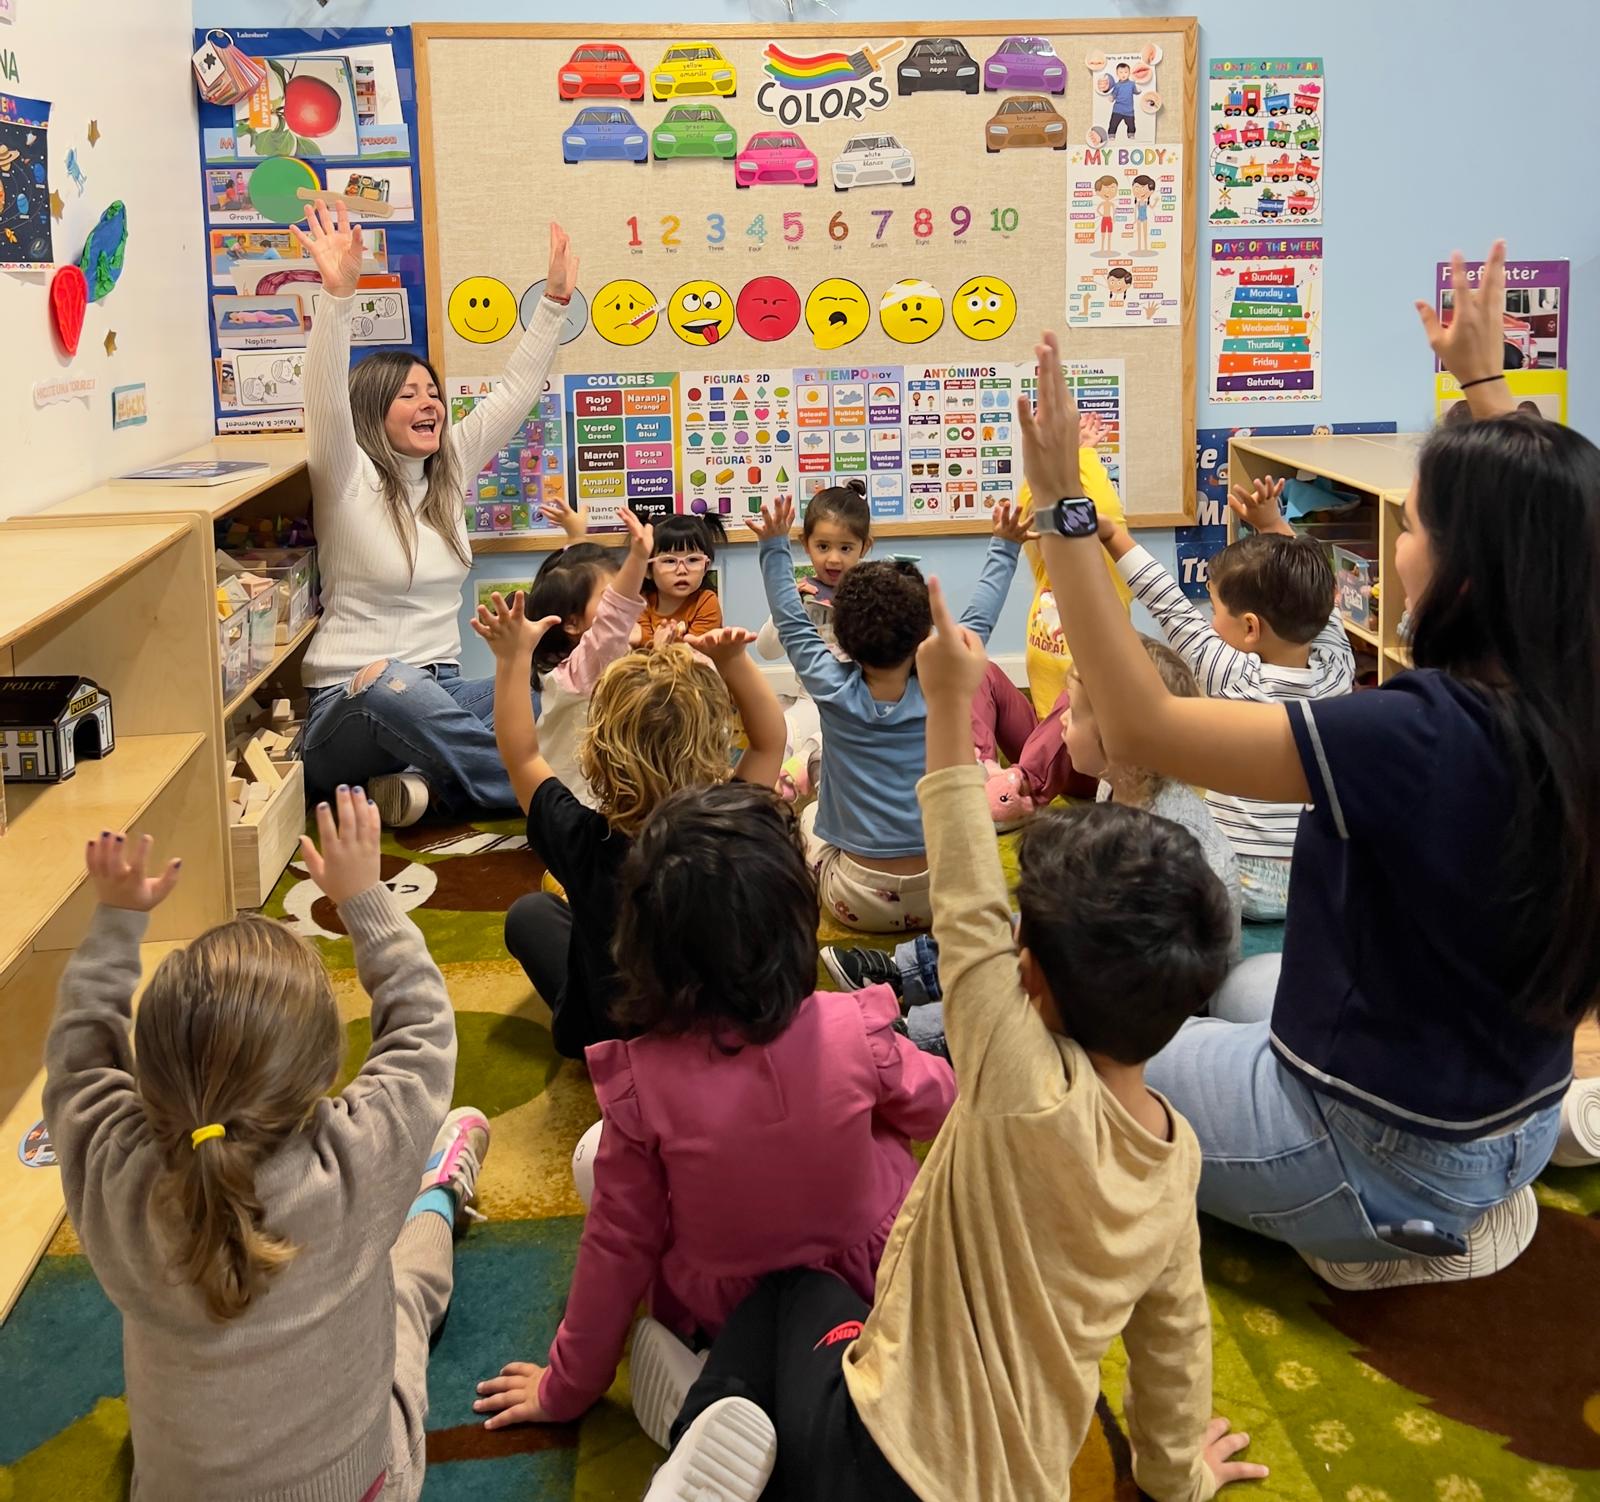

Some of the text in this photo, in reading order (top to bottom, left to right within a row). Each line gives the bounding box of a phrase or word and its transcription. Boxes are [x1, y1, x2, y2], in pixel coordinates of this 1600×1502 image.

[682, 62, 703, 70] yellow
[929, 67, 948, 75] negro
[1259, 62, 1273, 71] OF
[757, 76, 890, 126] COLORS
[1084, 148, 1166, 166] MY BODY
[863, 160, 884, 168] blanco
[228, 213, 254, 222] Group
[914, 207, 933, 238] 8
[951, 205, 972, 237] 9
[991, 207, 1019, 232] 10
[627, 216, 642, 246] 1
[661, 215, 682, 246] 2
[706, 213, 727, 244] 3
[746, 214, 768, 245] 4
[783, 212, 805, 243] 5
[828, 210, 849, 241] 6
[871, 210, 894, 240] 7
[1214, 240, 1319, 254] DAYS OF THE WEEK
[1251, 272, 1283, 284] Sunday
[1249, 288, 1283, 300] Monday
[1248, 306, 1283, 318] Tuesday
[1241, 322, 1289, 334] Wednesday
[245, 337, 277, 345] Naptime
[1246, 340, 1284, 352] Thursday
[1252, 357, 1278, 369] Friday
[805, 368, 892, 382] EL TIEMPO HOY
[923, 366, 997, 379] ANTÓNIMOS
[588, 374, 655, 387] COLORES
[703, 373, 770, 385] FIGURAS 2D
[1084, 377, 1112, 386] Sunday
[1246, 377, 1284, 389] Saturday
[460, 385, 474, 395] EL
[1084, 388, 1113, 396] Monday
[586, 396, 612, 406] Rojo
[627, 394, 667, 405] Naranja
[1082, 401, 1114, 410] Tuesday
[273, 419, 297, 427] Music
[583, 424, 616, 433] Verde
[636, 423, 659, 431] Azul
[584, 450, 619, 460] Marrón
[636, 450, 663, 458] Rosa
[706, 454, 773, 466] FIGURAS 3D
[872, 453, 901, 461] Ventoso
[589, 459, 614, 467] Brown
[582, 478, 620, 487] Amarillo
[631, 477, 668, 486] Morado
[590, 486, 615, 495] Yellow
[637, 485, 664, 493] Purple
[635, 503, 665, 513] Negro
[2, 681, 60, 691] POLICE
[71, 692, 99, 714] POLICE
